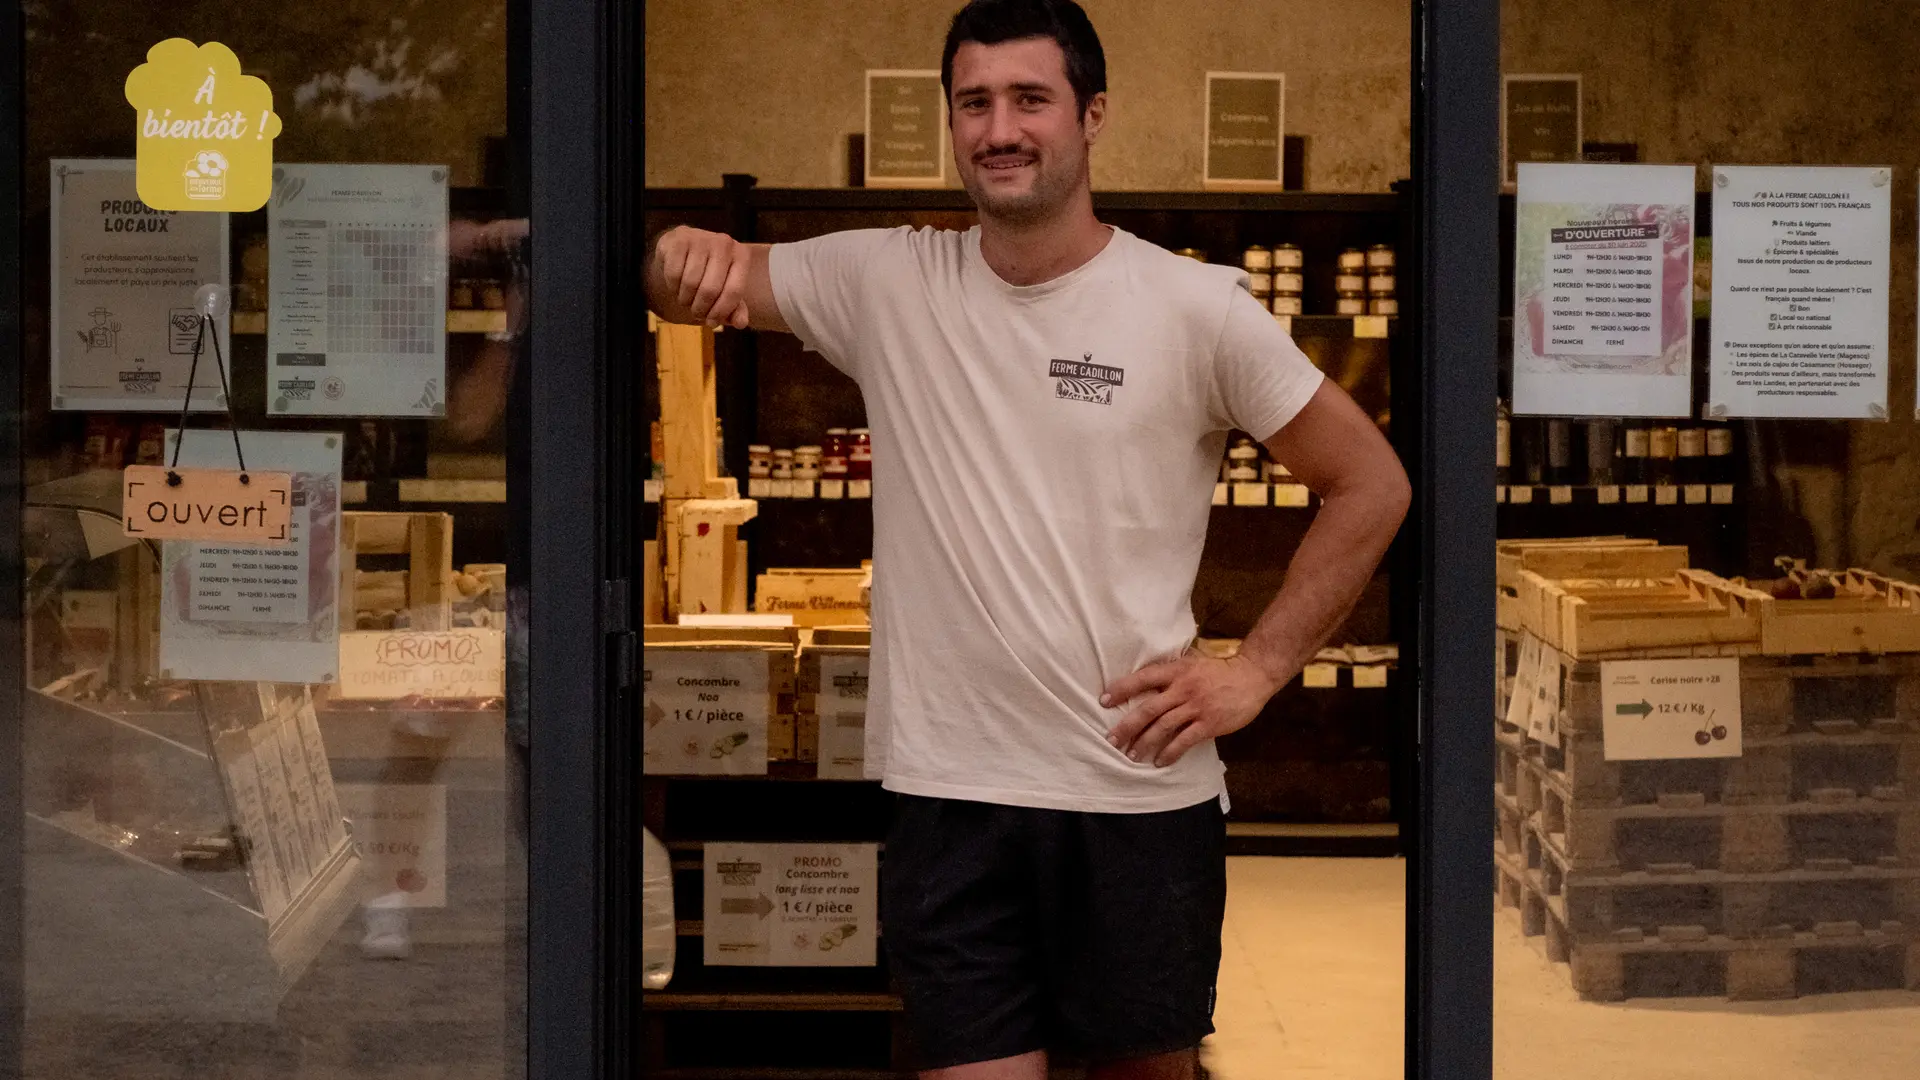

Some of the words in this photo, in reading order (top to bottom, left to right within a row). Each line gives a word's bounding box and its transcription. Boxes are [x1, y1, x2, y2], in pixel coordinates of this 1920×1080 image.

[193, 66, 216, 105] À
[142, 108, 248, 140] bientôt
[256, 110, 269, 140] !
[101, 200, 178, 214] PRODU
[104, 218, 168, 233] LOCAUX
[1565, 228, 1645, 240] D'OUVERTURE
[81, 254, 95, 262] Cet
[96, 253, 152, 262] établissement
[1052, 362, 1078, 375] FERME
[1080, 366, 1121, 382] CADILLON
[147, 501, 267, 527] ouvert
[385, 638, 472, 660] PROMO
[352, 670, 420, 685] TOMATE
[677, 676, 740, 687] Concombre
[1650, 676, 1678, 685] Cerise
[1680, 675, 1703, 684] noire
[697, 693, 719, 702] Noa
[1658, 703, 1670, 714] 12
[1673, 704, 1681, 713] €
[1691, 703, 1705, 715] Kg
[674, 710, 680, 721] 1
[686, 710, 694, 721] €
[697, 709, 702, 721] /
[706, 709, 744, 724] pièce
[794, 856, 842, 868] PROMO
[785, 869, 849, 879] Concombre
[775, 885, 798, 896] long
[800, 885, 823, 894] lisse
[826, 886, 838, 894] et
[842, 886, 860, 894] noa
[783, 902, 789, 913] 1
[794, 902, 802, 913] €
[805, 902, 812, 913] /
[815, 901, 853, 916] pièce
